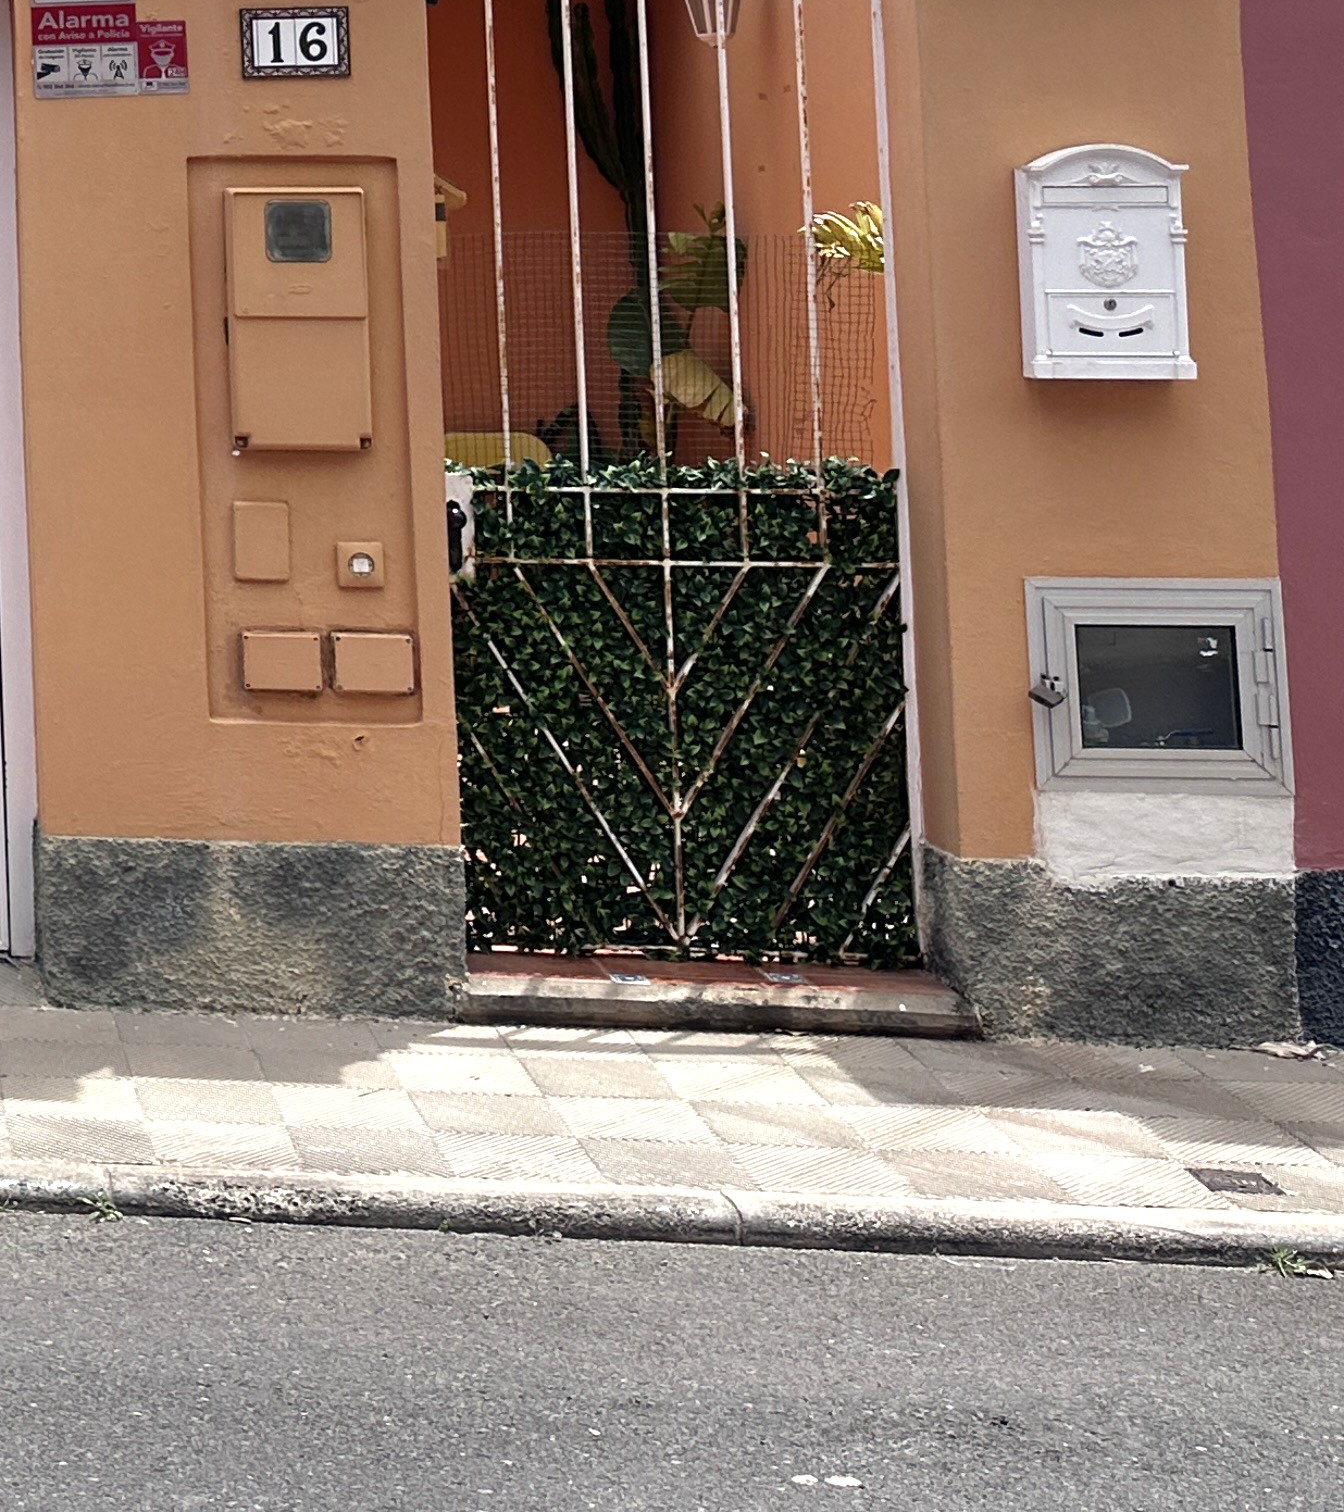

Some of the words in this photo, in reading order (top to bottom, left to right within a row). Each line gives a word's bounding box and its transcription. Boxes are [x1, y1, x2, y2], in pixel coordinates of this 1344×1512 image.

[38, 10, 129, 30] Alarma
[37, 33, 56, 41] con
[58, 31, 87, 40] Aviso
[139, 23, 184, 35] Vigilante
[268, 21, 328, 63] 16
